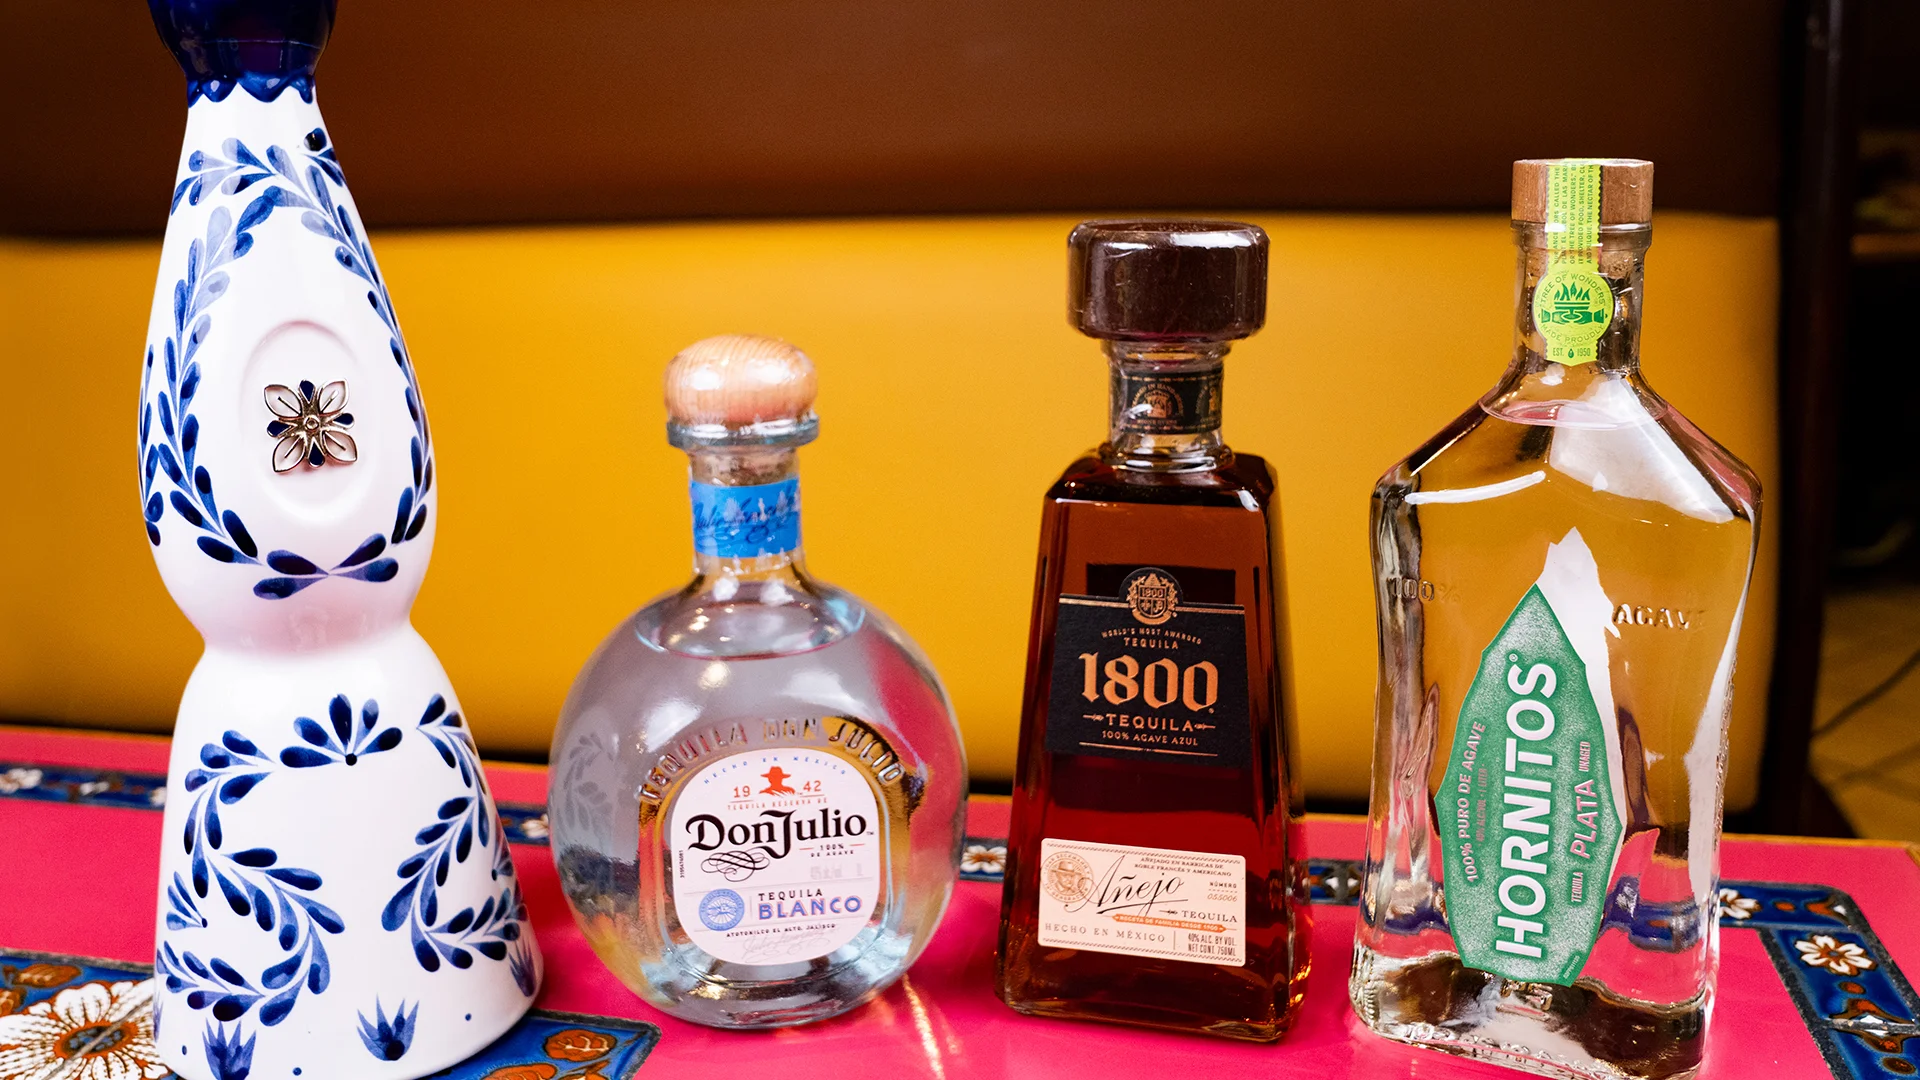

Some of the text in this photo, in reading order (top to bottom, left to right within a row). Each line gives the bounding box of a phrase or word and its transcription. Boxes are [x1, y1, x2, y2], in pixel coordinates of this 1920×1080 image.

[1587, 174, 1593, 183] OF
[1570, 212, 1576, 220] OF
[1570, 256, 1576, 264] OR
[1556, 274, 1567, 284] OF
[1541, 324, 1604, 342] MADE PROUDLY
[1552, 348, 1591, 356] EST. 1950
[1101, 628, 1136, 638] WORLD'S
[1164, 630, 1202, 645] AWARDED
[1124, 637, 1178, 650] TEQUILA
[1078, 652, 1218, 712] 1800
[1106, 713, 1194, 732] TEQUILA
[1102, 730, 1198, 746] 100% AGAVE AZUL
[639, 717, 906, 800] TEQUILA DON JULIO
[704, 761, 748, 784] HECHO
[734, 780, 822, 798] 19 42
[727, 802, 766, 810] TEQUILA
[772, 799, 812, 808] RESERVA
[1457, 720, 1486, 882] 100% PURO DE AGAVE
[1496, 662, 1557, 958] HORNITOS
[1570, 740, 1598, 903] TEQUILA PLATA UNAGED
[1141, 857, 1170, 865] AÑEJADO
[1182, 860, 1214, 868] BARRICAS
[1156, 865, 1185, 873] FRANCÉS
[1064, 854, 1184, 916] Añejo
[1210, 880, 1238, 888] NÚMERO
[758, 888, 823, 901] TEQUILA
[758, 895, 862, 920] BLANCO
[1182, 910, 1238, 923] TEQUILA
[726, 929, 770, 938] ATOTONILCO
[1045, 922, 1166, 943] HECHO EN MÉXICO
[1188, 933, 1237, 946] 40% ALC. BY VOL.
[1188, 944, 1198, 952] NET
[1218, 946, 1236, 956] 750ML
